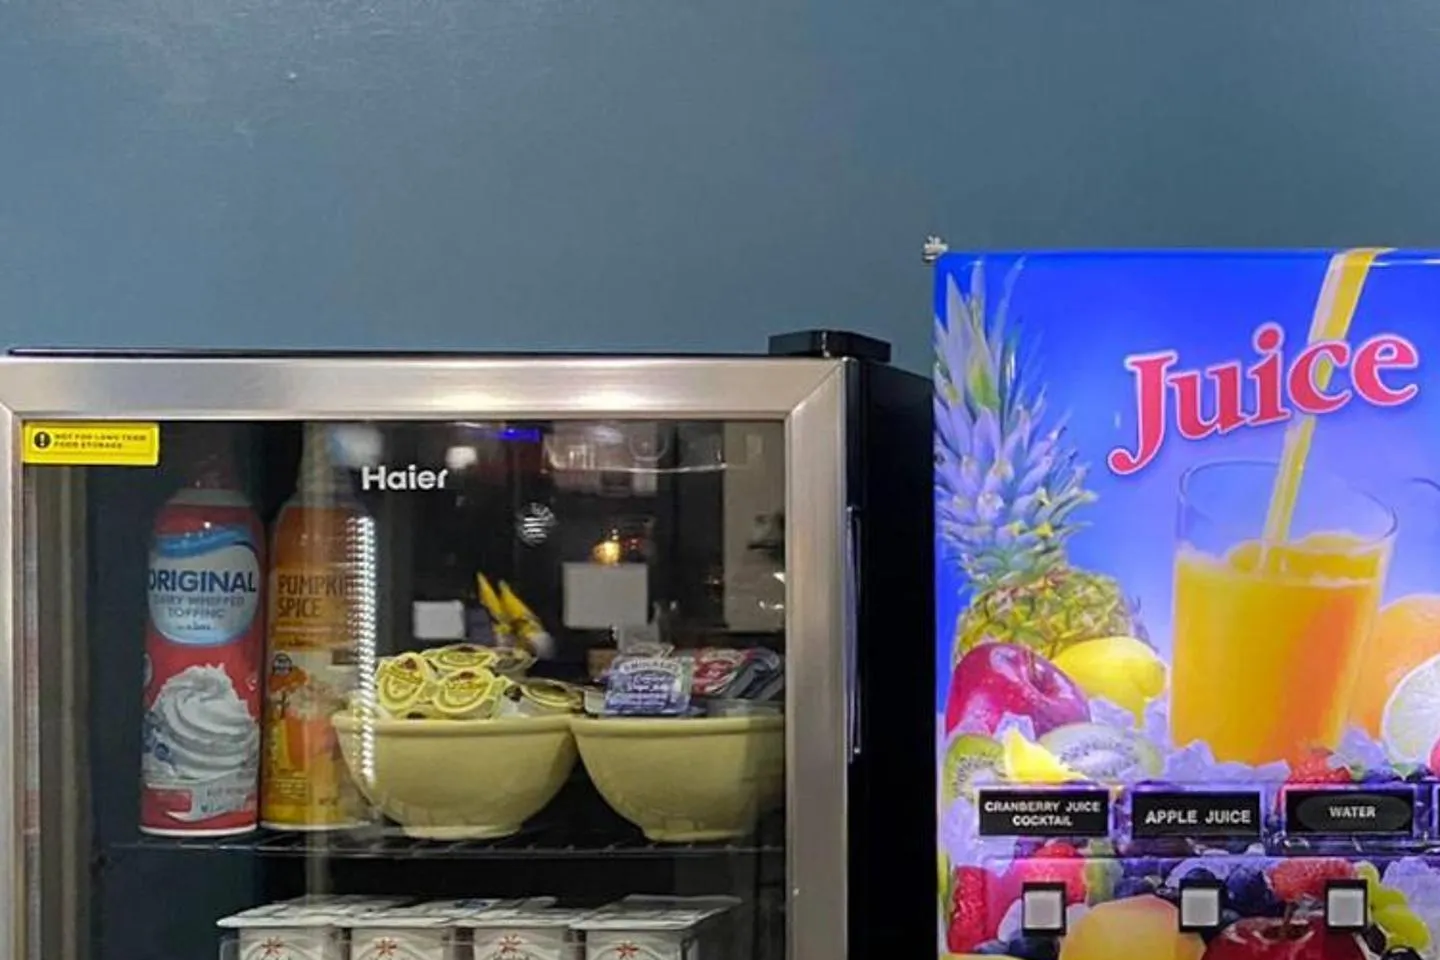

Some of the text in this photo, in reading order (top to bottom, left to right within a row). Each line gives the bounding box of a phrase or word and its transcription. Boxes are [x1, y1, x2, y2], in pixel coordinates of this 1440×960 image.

[1107, 322, 1420, 475] Juice
[361, 464, 449, 491] Haier
[277, 597, 322, 618] SPICE
[984, 800, 1101, 814] CRANBERRY JUICE
[1329, 805, 1377, 819] WATER
[1012, 814, 1074, 828] COCKTAIL
[1145, 808, 1252, 826] APPLE JUICE
